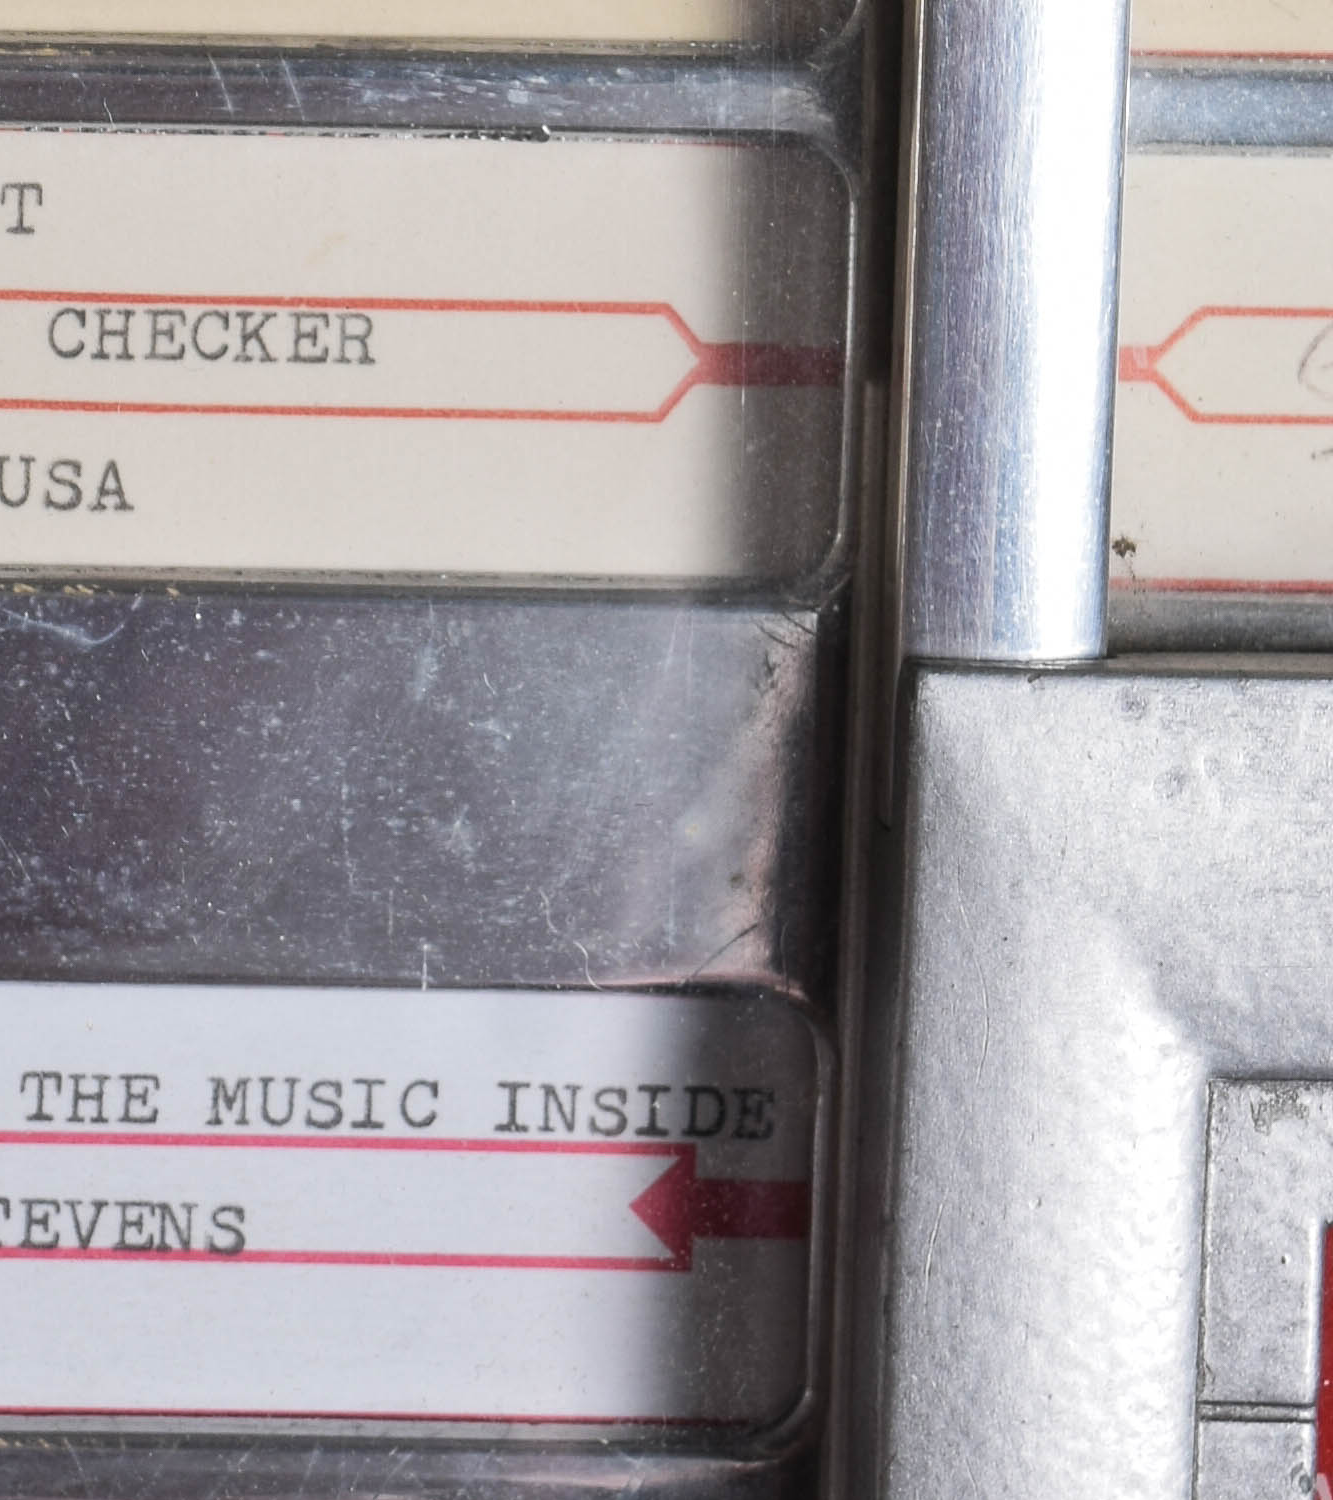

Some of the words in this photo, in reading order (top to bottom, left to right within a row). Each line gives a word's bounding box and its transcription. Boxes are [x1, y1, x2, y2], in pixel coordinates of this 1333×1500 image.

[48, 307, 376, 365] CHECKER
[20, 1071, 161, 1125] THE
[205, 1077, 439, 1131] MUSIC
[484, 1081, 773, 1140] INSIDE
